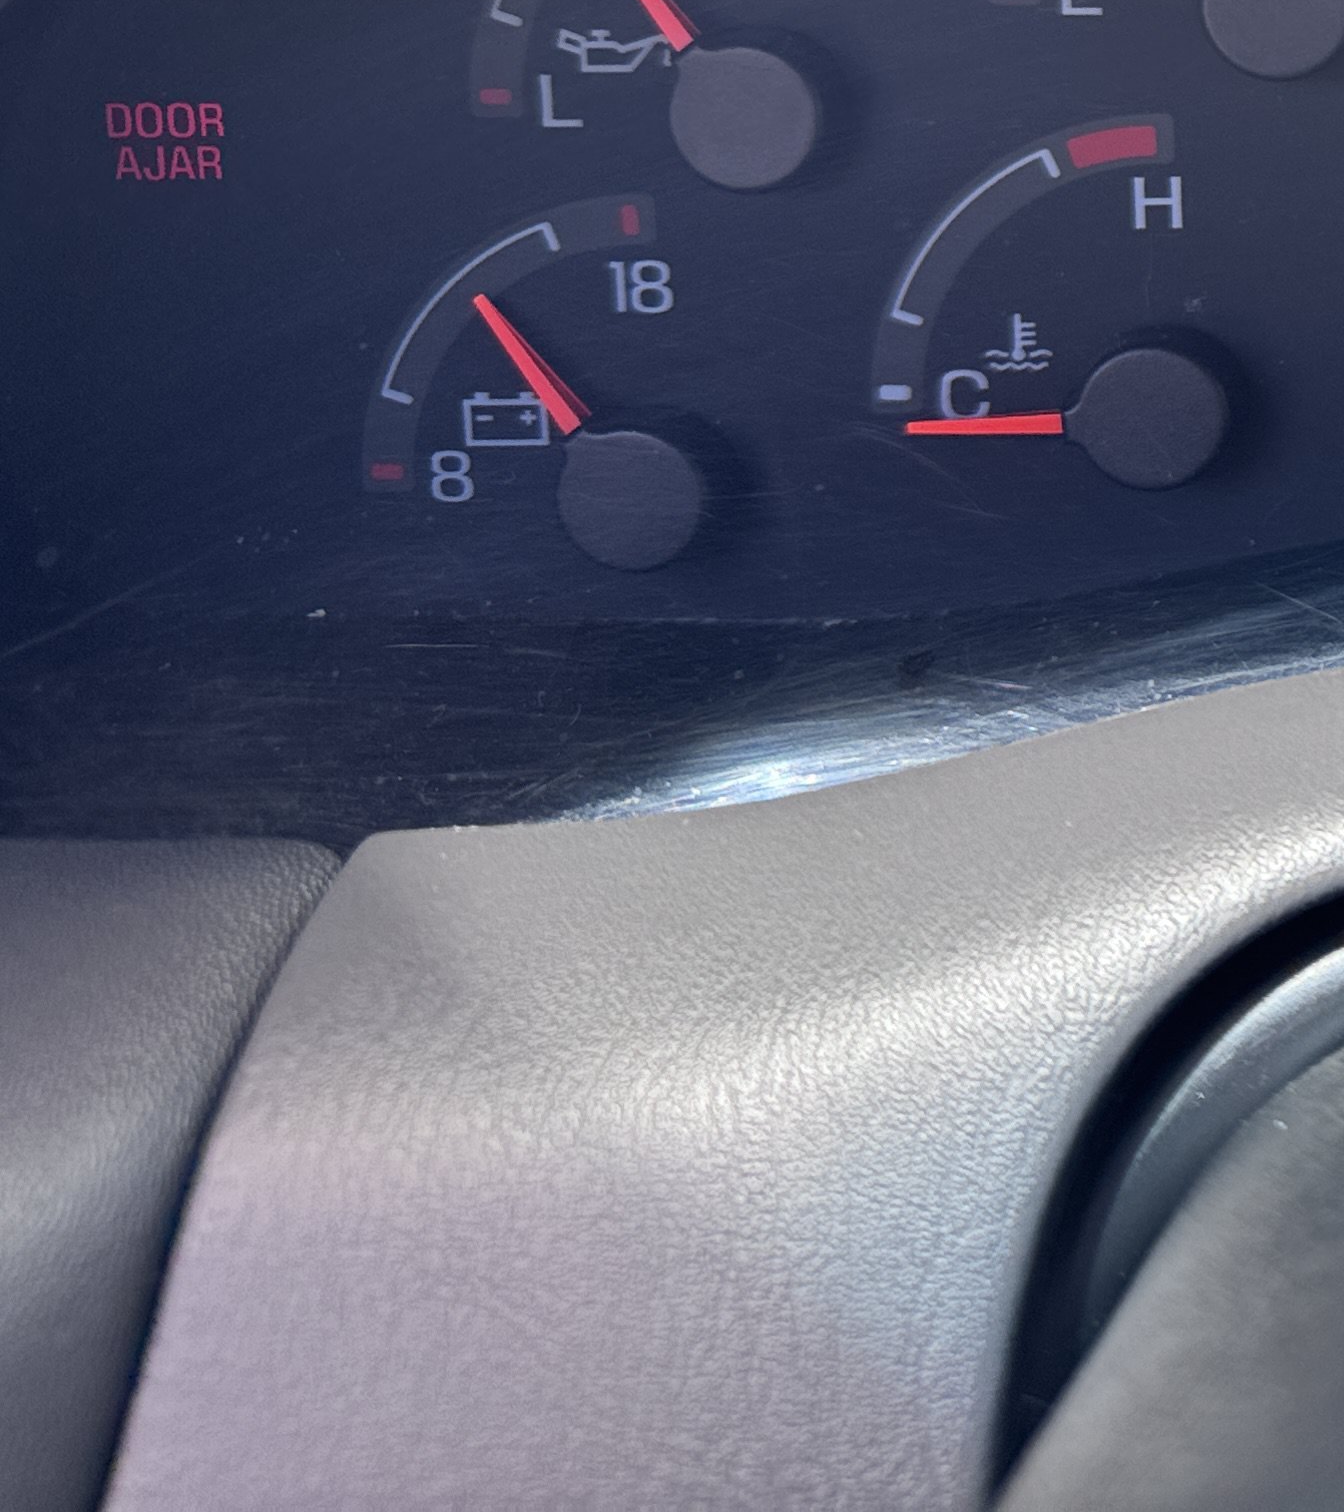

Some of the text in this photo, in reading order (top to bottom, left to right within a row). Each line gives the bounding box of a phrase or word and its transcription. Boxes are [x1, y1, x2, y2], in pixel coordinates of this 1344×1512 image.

[106, 102, 225, 138] DOOR
[539, 74, 583, 128] L
[116, 145, 223, 181] AJAR
[1133, 176, 1183, 230] H
[608, 259, 673, 314] 18
[940, 368, 991, 418] C
[430, 450, 474, 503] 8
